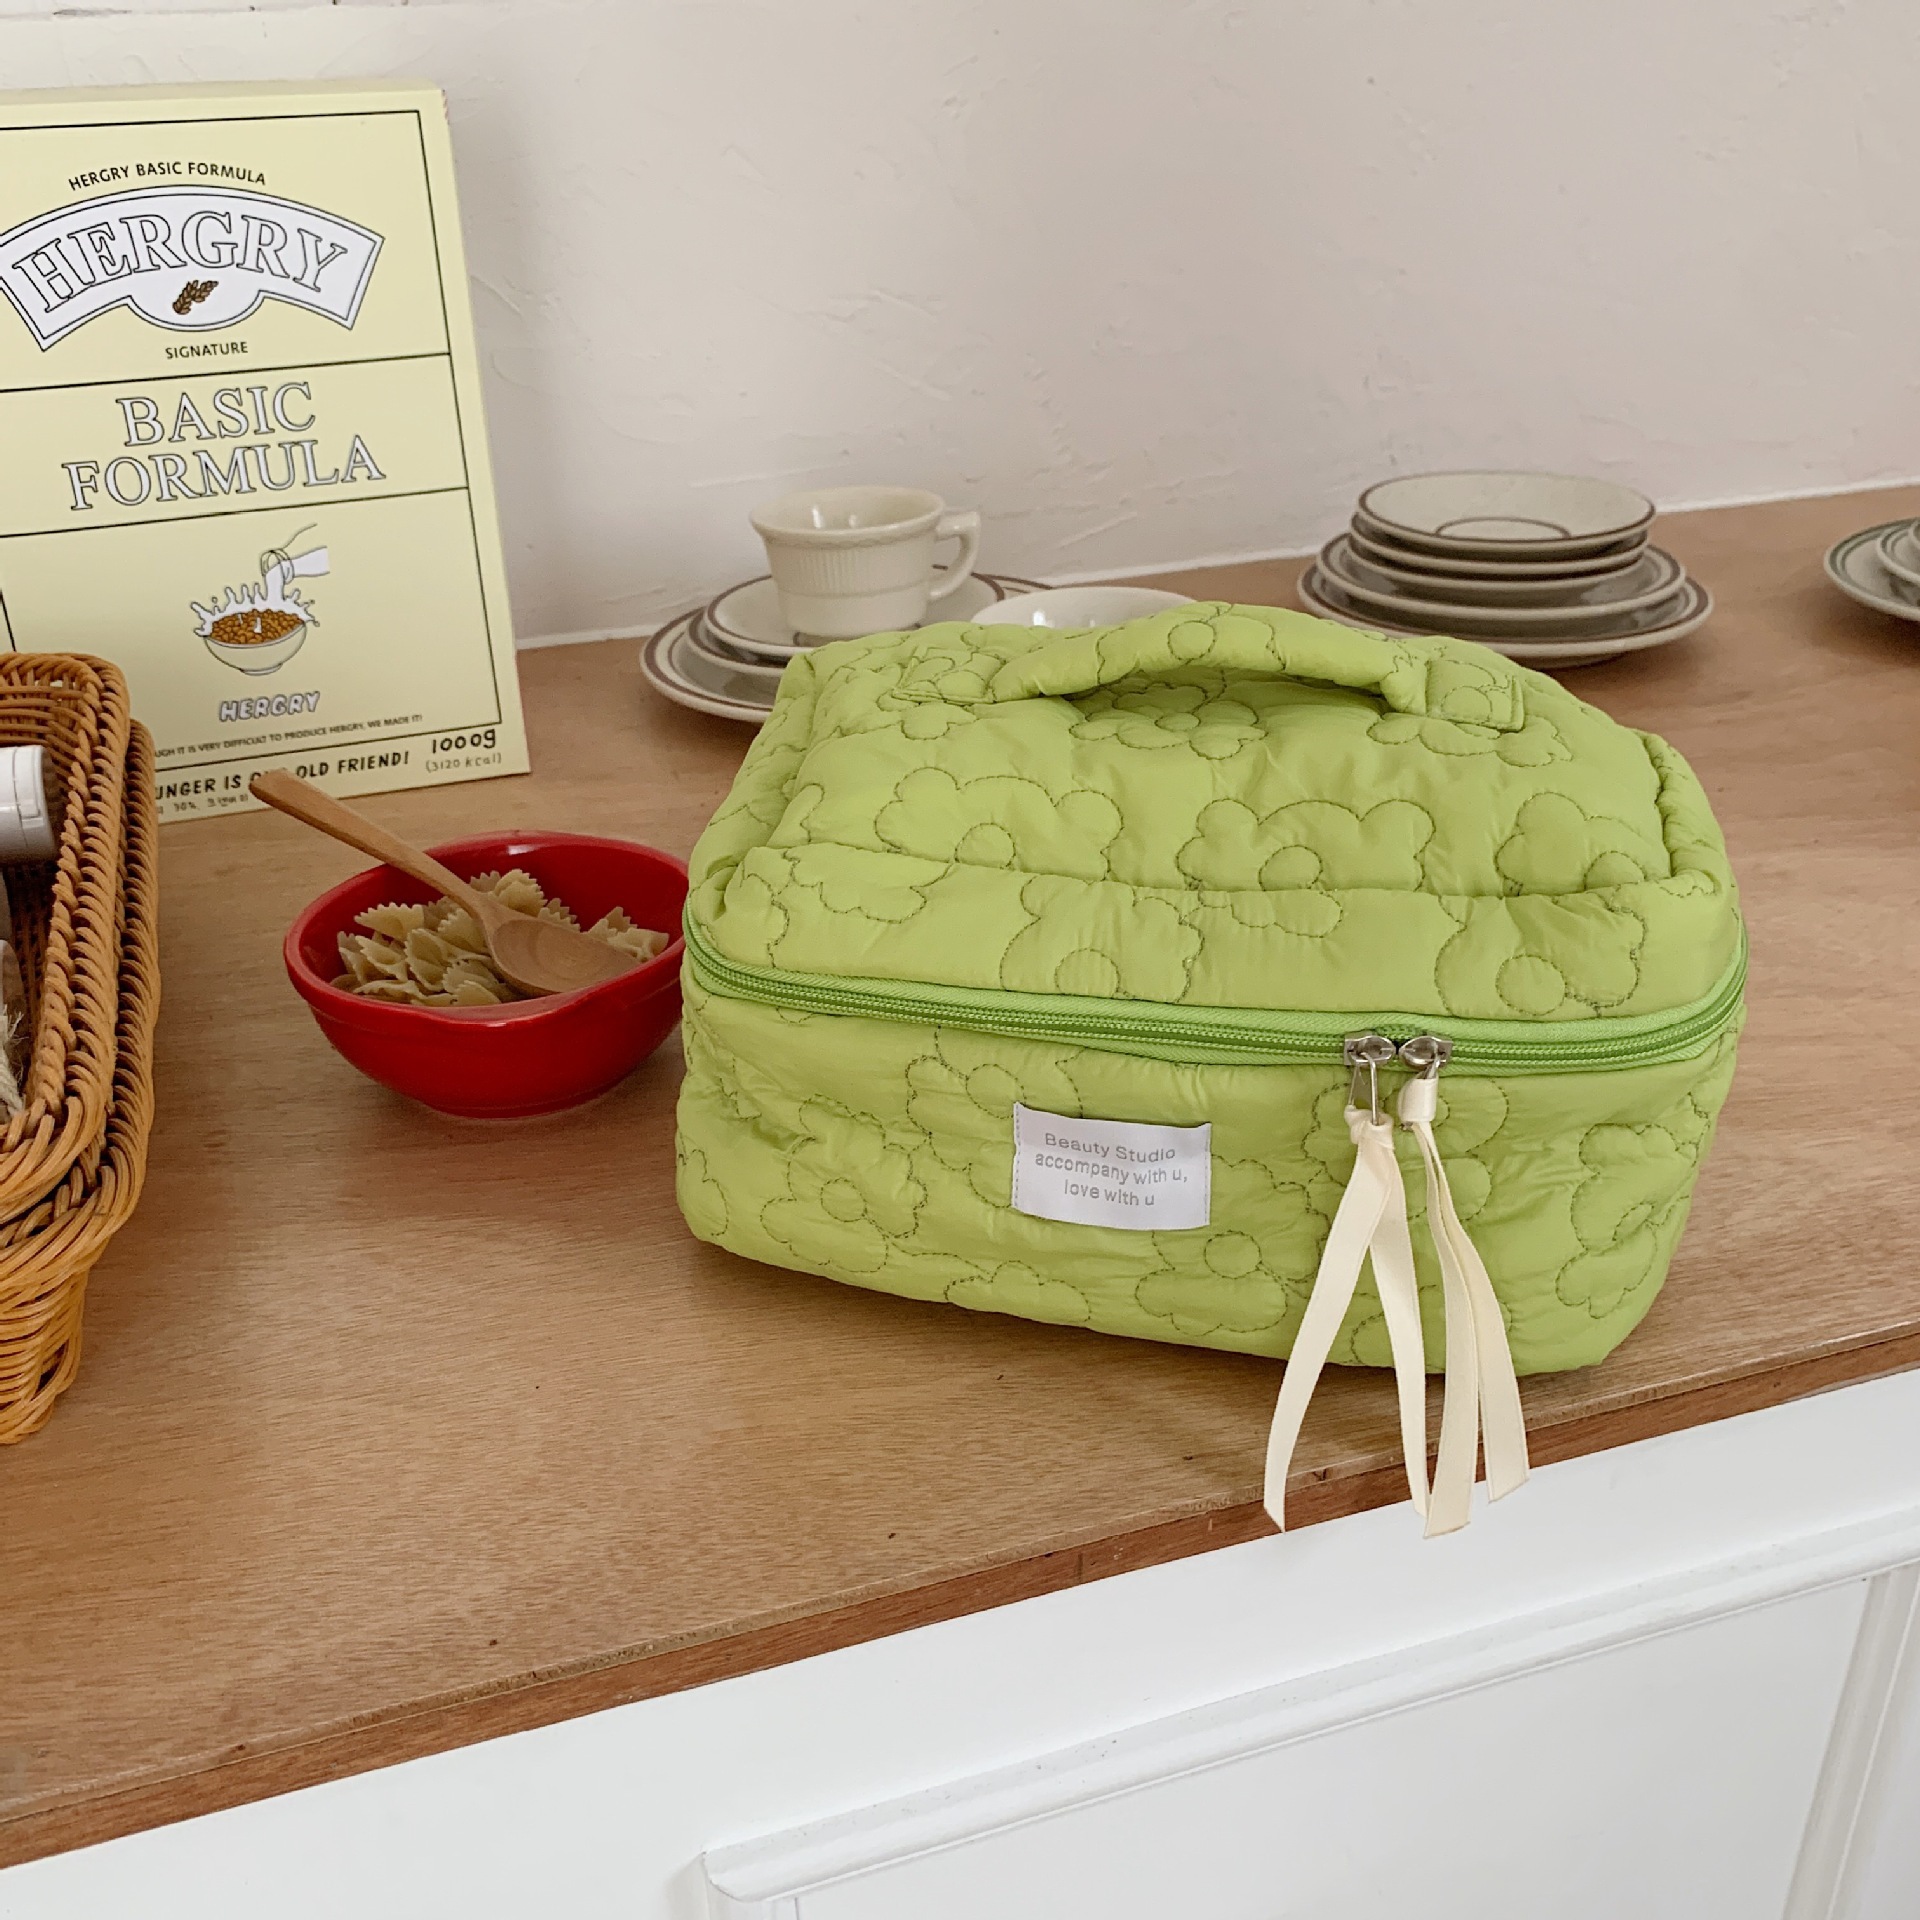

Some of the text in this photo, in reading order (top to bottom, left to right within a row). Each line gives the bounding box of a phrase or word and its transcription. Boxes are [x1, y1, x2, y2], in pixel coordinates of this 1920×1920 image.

[68, 162, 266, 191] HERGRY BASIC FORMULA
[12, 211, 348, 313] HERGRY
[165, 341, 249, 359] SIGNATURE
[115, 382, 316, 447] BASIC
[61, 435, 386, 511] FORMULA
[219, 690, 321, 722] HERGRY
[155, 748, 175, 758] UGH
[198, 742, 221, 752] VERY
[223, 735, 267, 749] DIFFICULT
[269, 733, 282, 742] TO
[284, 727, 327, 740] PRODUCE
[367, 719, 382, 729] WE
[383, 715, 409, 727] MADE
[432, 728, 496, 754] 1000g
[155, 777, 216, 800] UNGER
[225, 774, 242, 790] IS
[295, 762, 329, 779] OLD
[338, 750, 410, 775] FRIEND!
[1045, 1132, 1176, 1163] Beauty Studio
[1035, 1153, 1188, 1185] accompany with u,
[1064, 1179, 1155, 1206] love with u
